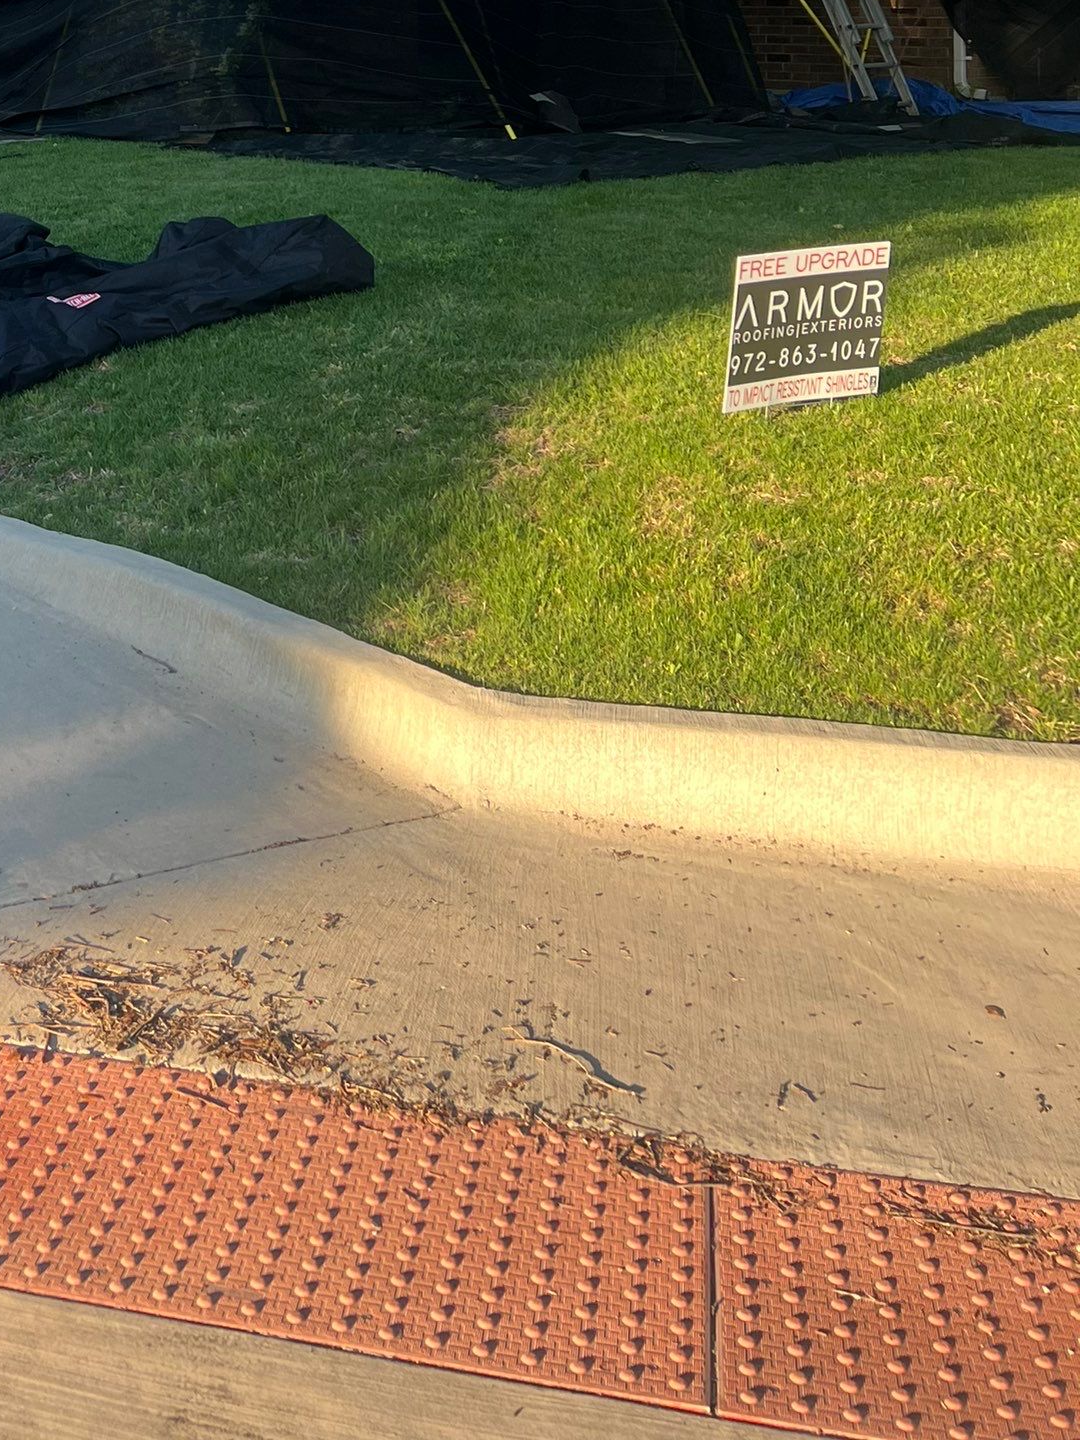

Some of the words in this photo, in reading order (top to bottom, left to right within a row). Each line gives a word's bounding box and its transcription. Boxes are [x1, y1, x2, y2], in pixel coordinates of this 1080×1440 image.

[739, 256, 788, 280] FREE
[795, 247, 888, 273] UPGRADE
[734, 279, 884, 330] ARMOR
[731, 337, 880, 376] 972-863-1047
[729, 389, 741, 407] TO
[743, 382, 775, 406] IMPACT
[776, 376, 824, 400] RESISTANT
[825, 372, 869, 394] SHINGLES
